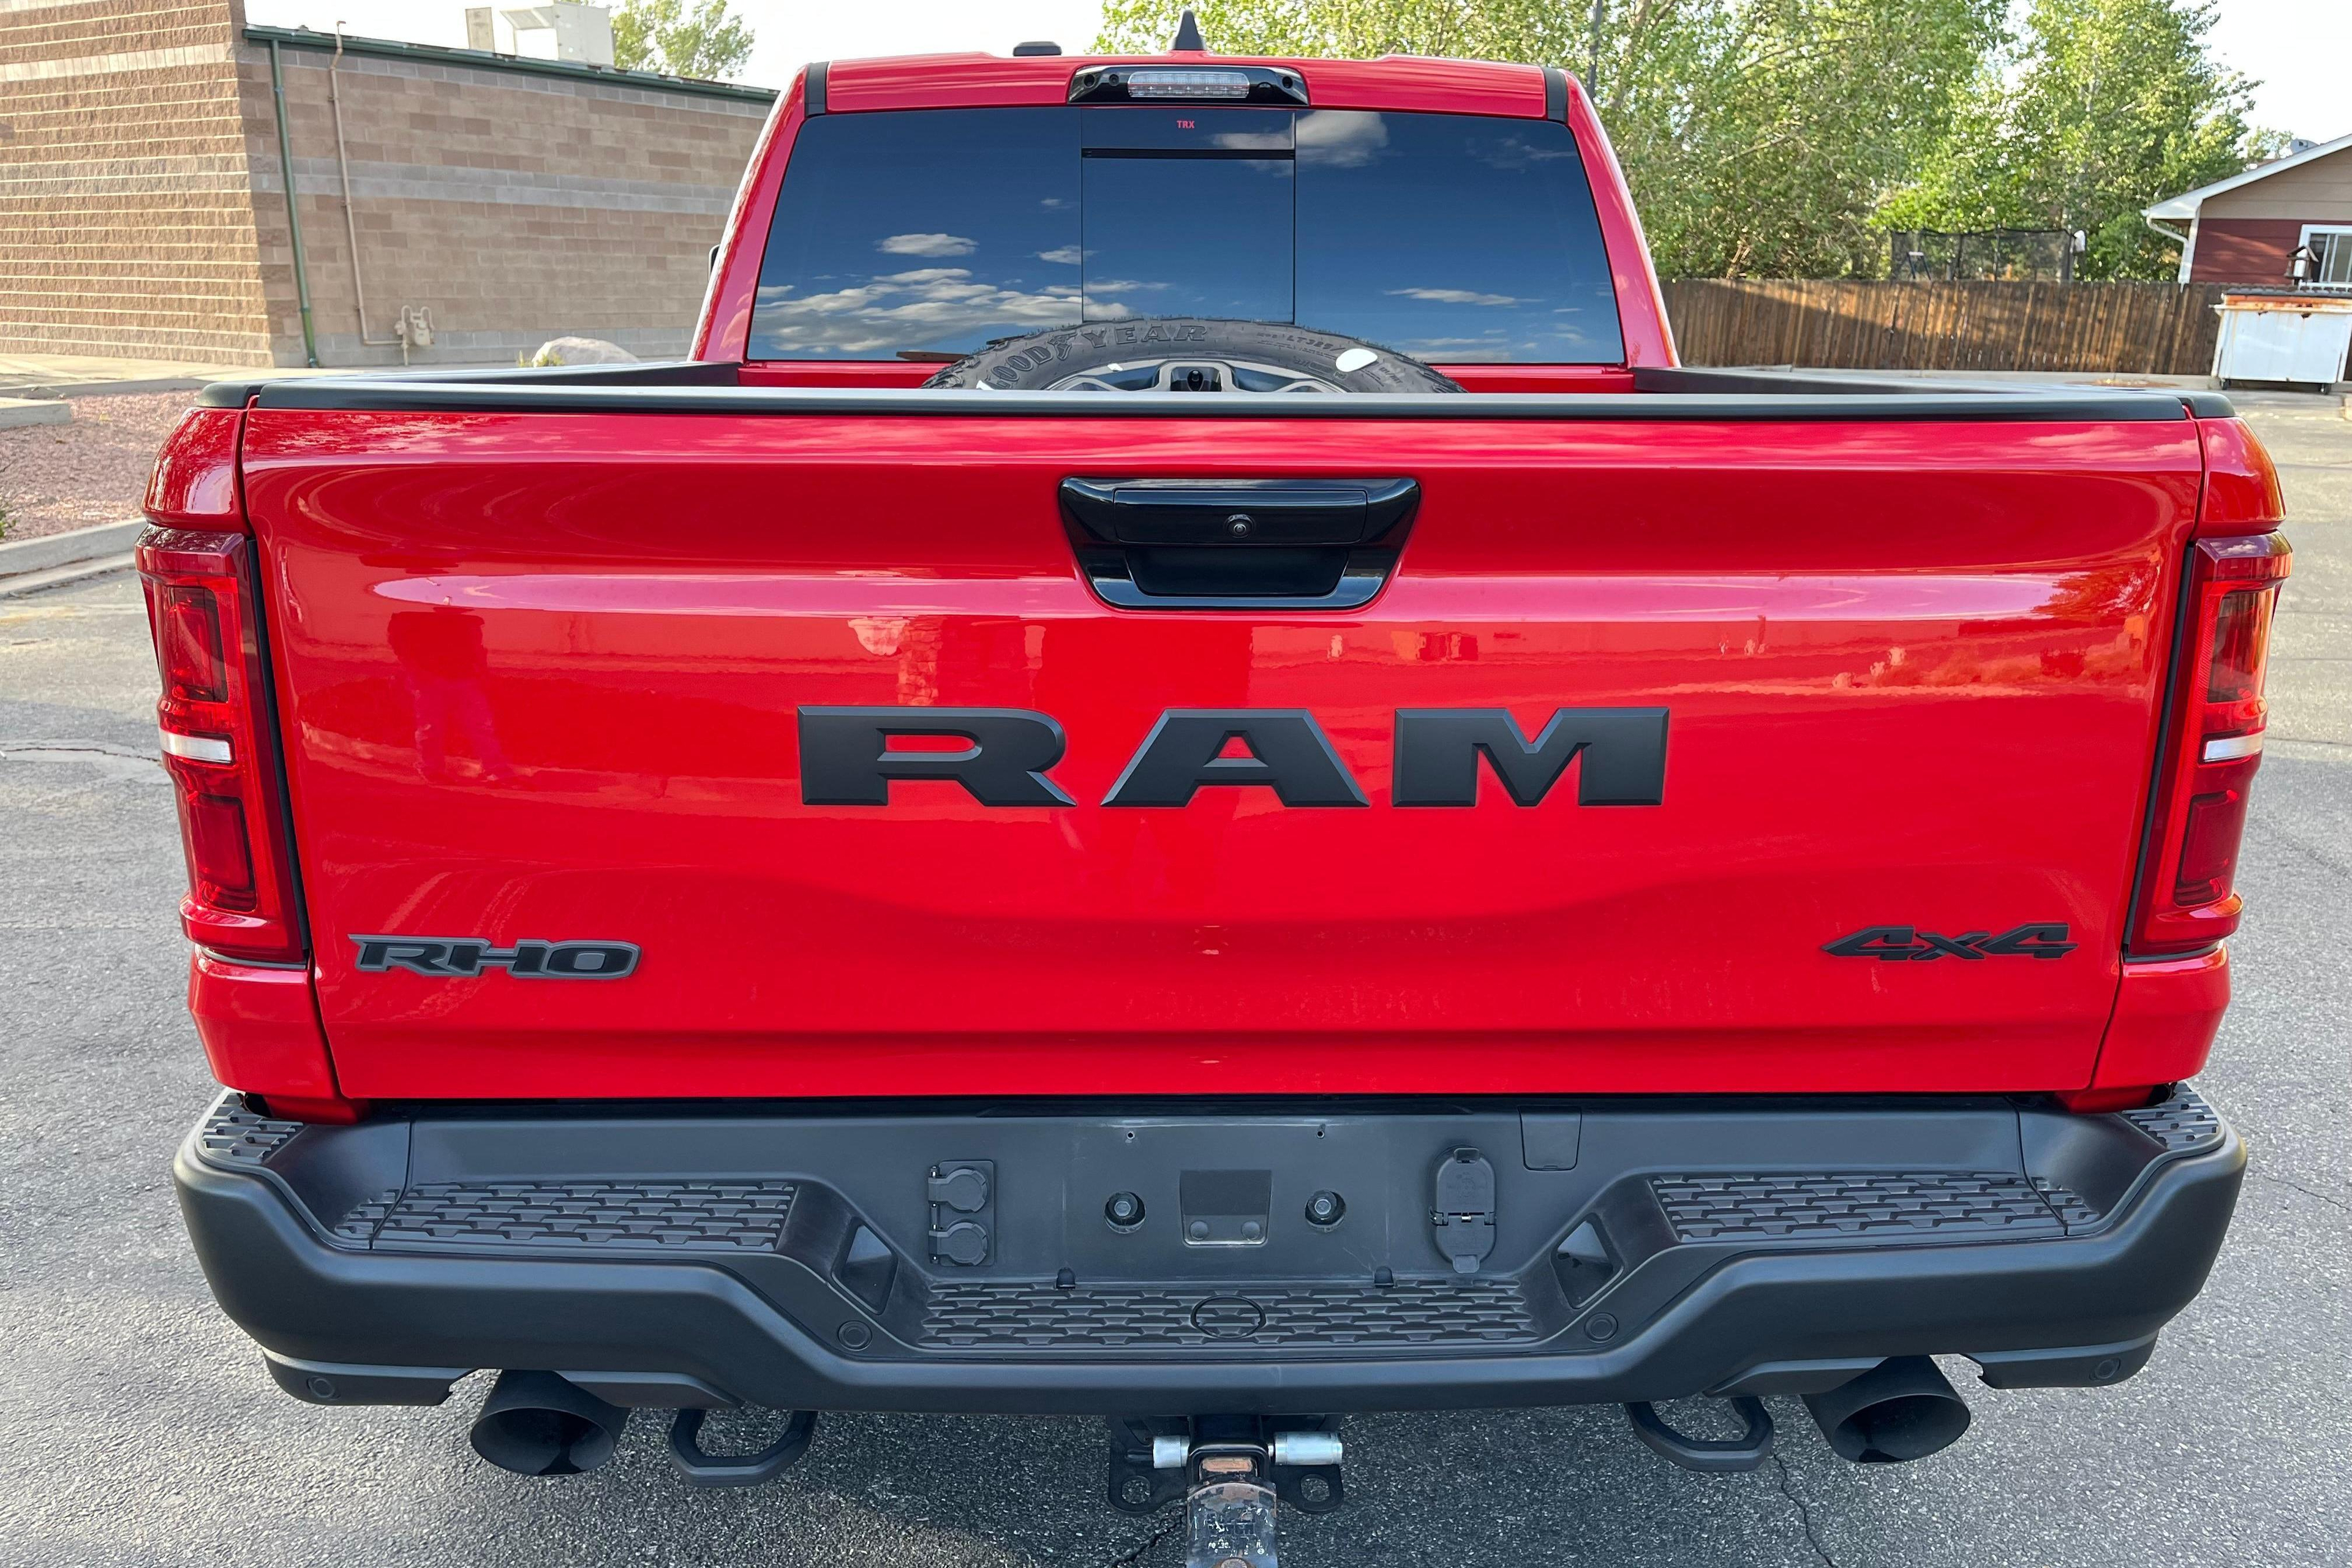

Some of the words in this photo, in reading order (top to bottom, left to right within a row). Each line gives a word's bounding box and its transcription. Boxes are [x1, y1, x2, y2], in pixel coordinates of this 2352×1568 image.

[1176, 120, 1195, 129] TRX
[798, 705, 1670, 807] RAM
[348, 933, 643, 980] RHO
[1821, 922, 2079, 960] 4x4
